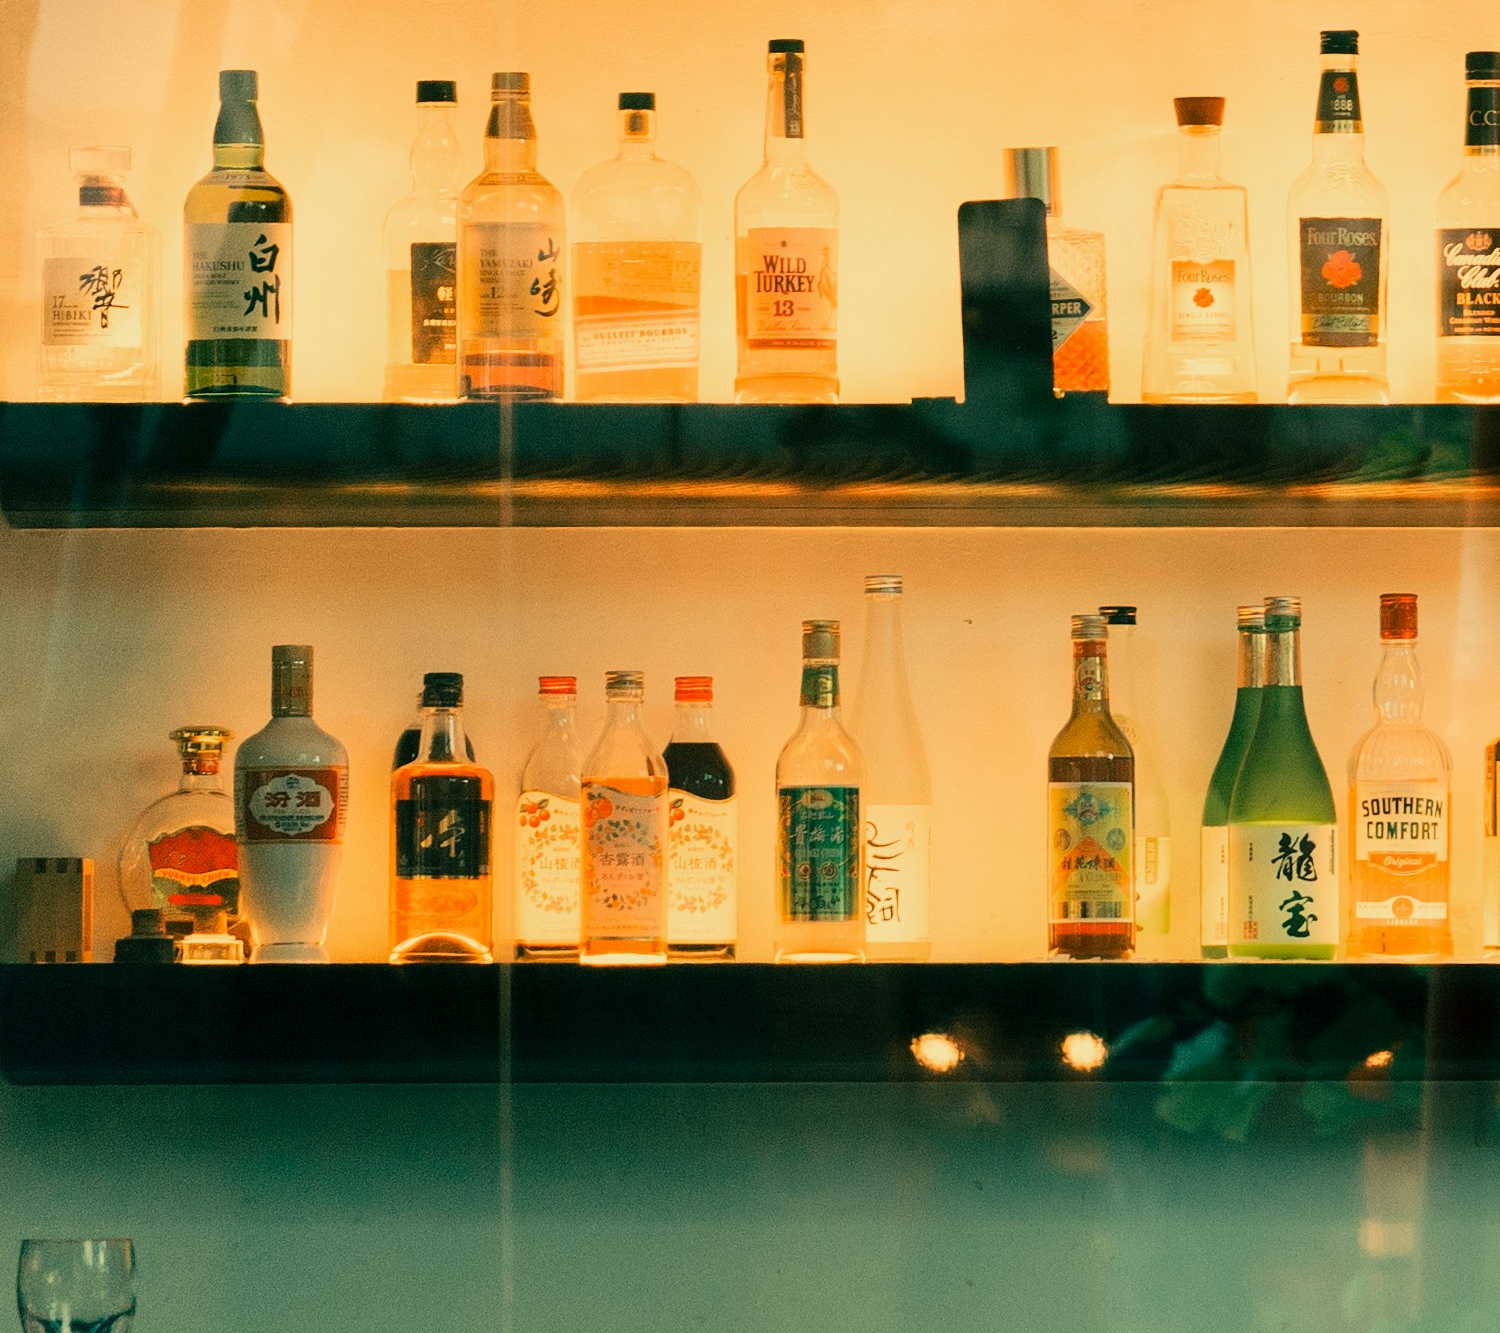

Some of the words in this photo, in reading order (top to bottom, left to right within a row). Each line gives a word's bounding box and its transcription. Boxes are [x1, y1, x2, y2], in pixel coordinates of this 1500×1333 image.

[1307, 227, 1337, 247] Four
[1337, 227, 1378, 247] Roses
[192, 261, 245, 271] HAKUSHU
[479, 258, 533, 270] YAMAZAKI
[763, 256, 807, 274] WILD
[243, 233, 280, 324] 白州
[529, 236, 563, 318] 山崎
[753, 271, 816, 294] TURKEY
[1177, 269, 1201, 284] Four
[1200, 268, 1231, 284] Roses
[51, 295, 64, 309] 17
[1317, 292, 1364, 303] BOURBON
[52, 310, 92, 321] HIBIKI
[773, 300, 795, 317] 13
[593, 328, 637, 341] BULLEIT
[638, 327, 688, 338] BOURBON
[264, 790, 322, 809] 汾酒
[1362, 795, 1443, 820] SOUTHERN
[1366, 820, 1439, 840] COMFORT
[598, 852, 646, 868] 杏露酒
[1383, 856, 1423, 868] Original
